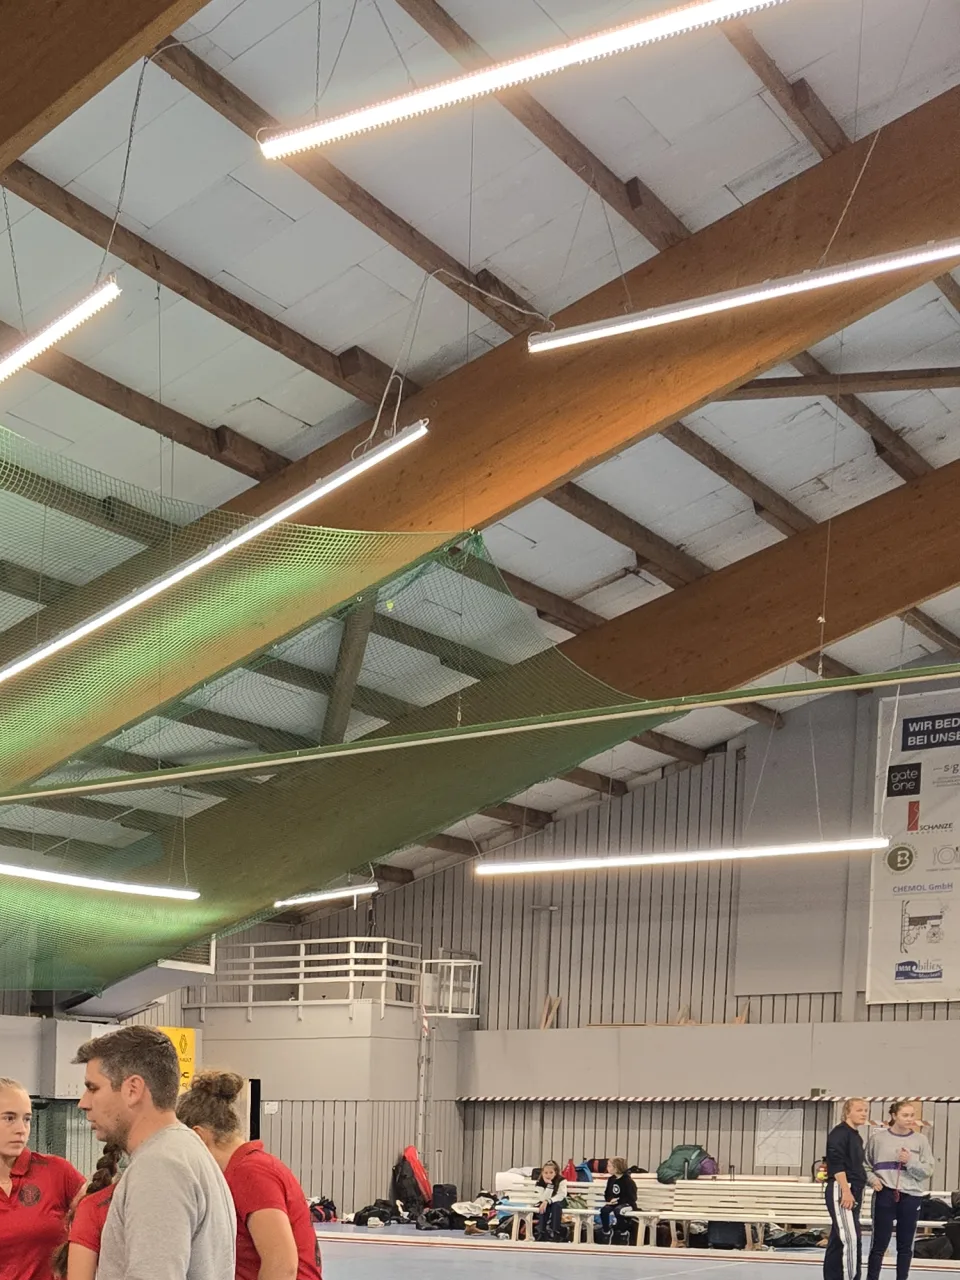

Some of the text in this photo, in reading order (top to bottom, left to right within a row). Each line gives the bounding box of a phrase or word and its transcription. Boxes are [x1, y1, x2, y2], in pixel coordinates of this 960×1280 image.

[908, 720, 933, 732] WIR
[908, 735, 928, 746] BEI
[891, 769, 918, 783] gate
[892, 781, 916, 791] one
[920, 823, 953, 831] SCHANZE
[892, 882, 953, 893] CHEMOL GmbH
